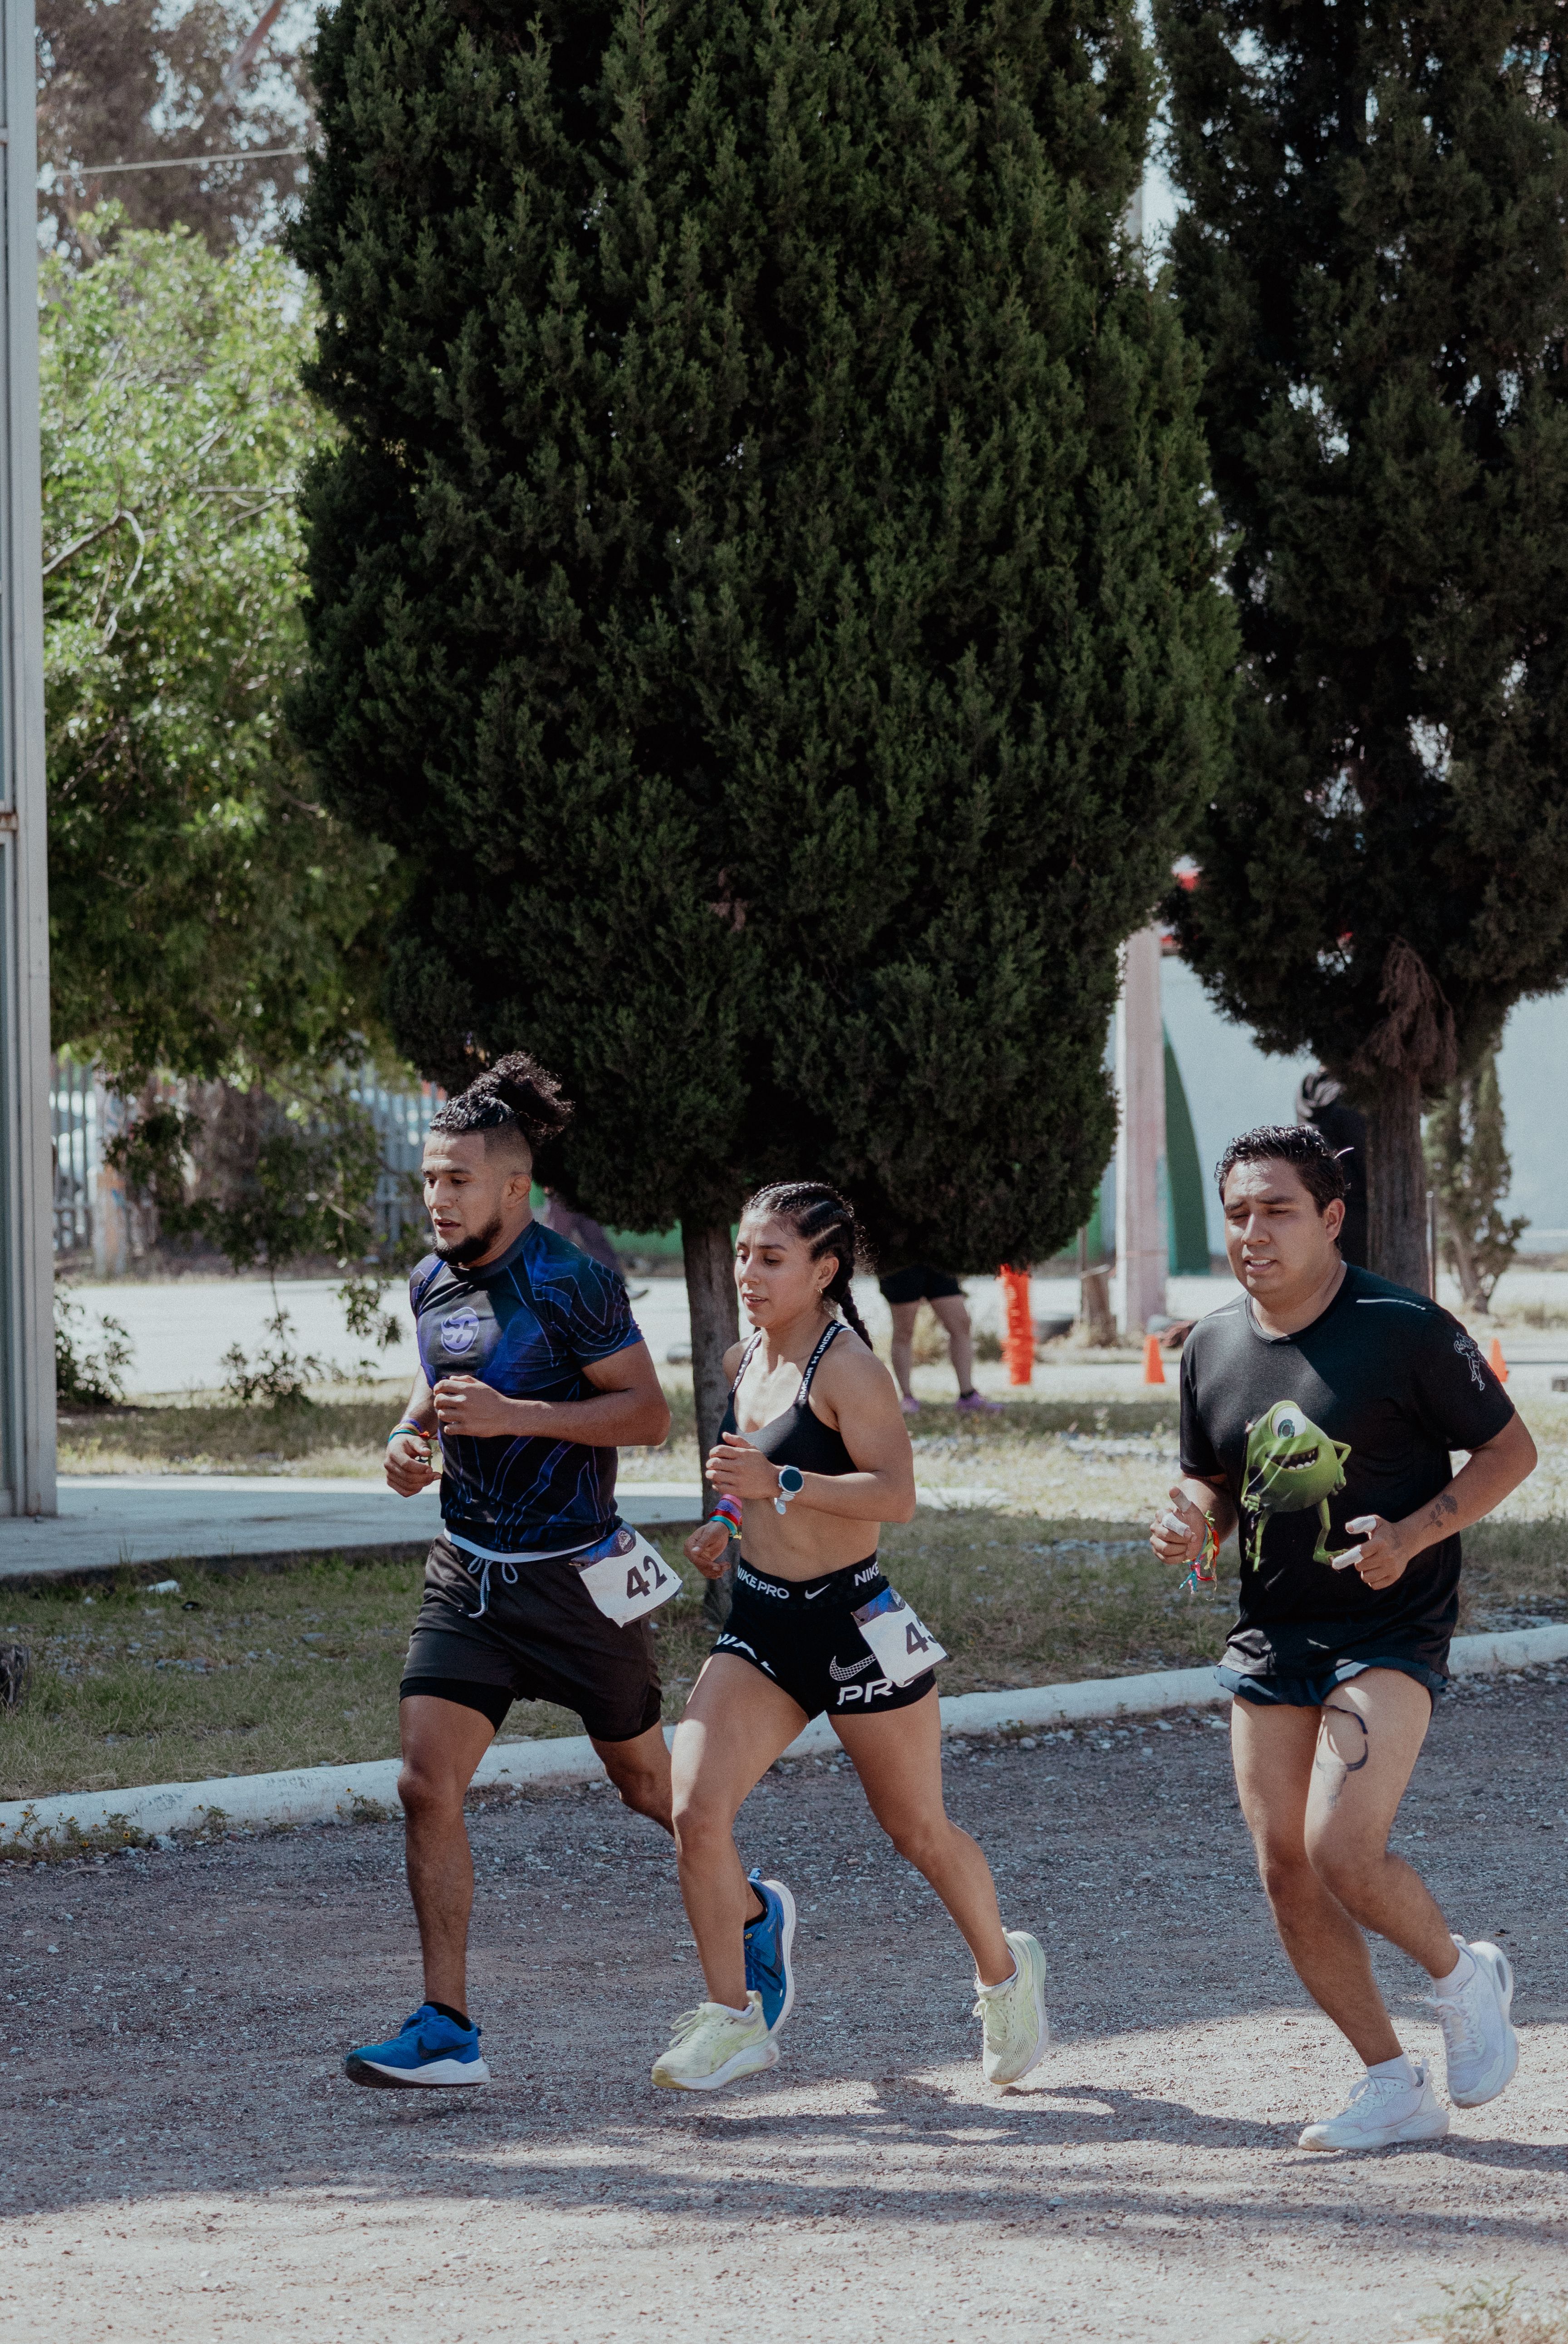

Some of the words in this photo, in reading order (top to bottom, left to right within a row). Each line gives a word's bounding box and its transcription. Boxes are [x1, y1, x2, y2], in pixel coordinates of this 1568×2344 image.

[816, 1326, 837, 1353] UNDER
[626, 1555, 668, 1599] 42
[854, 1561, 879, 1586] NIKE
[757, 1581, 789, 1599] PRO
[836, 1678, 914, 1705] PR
